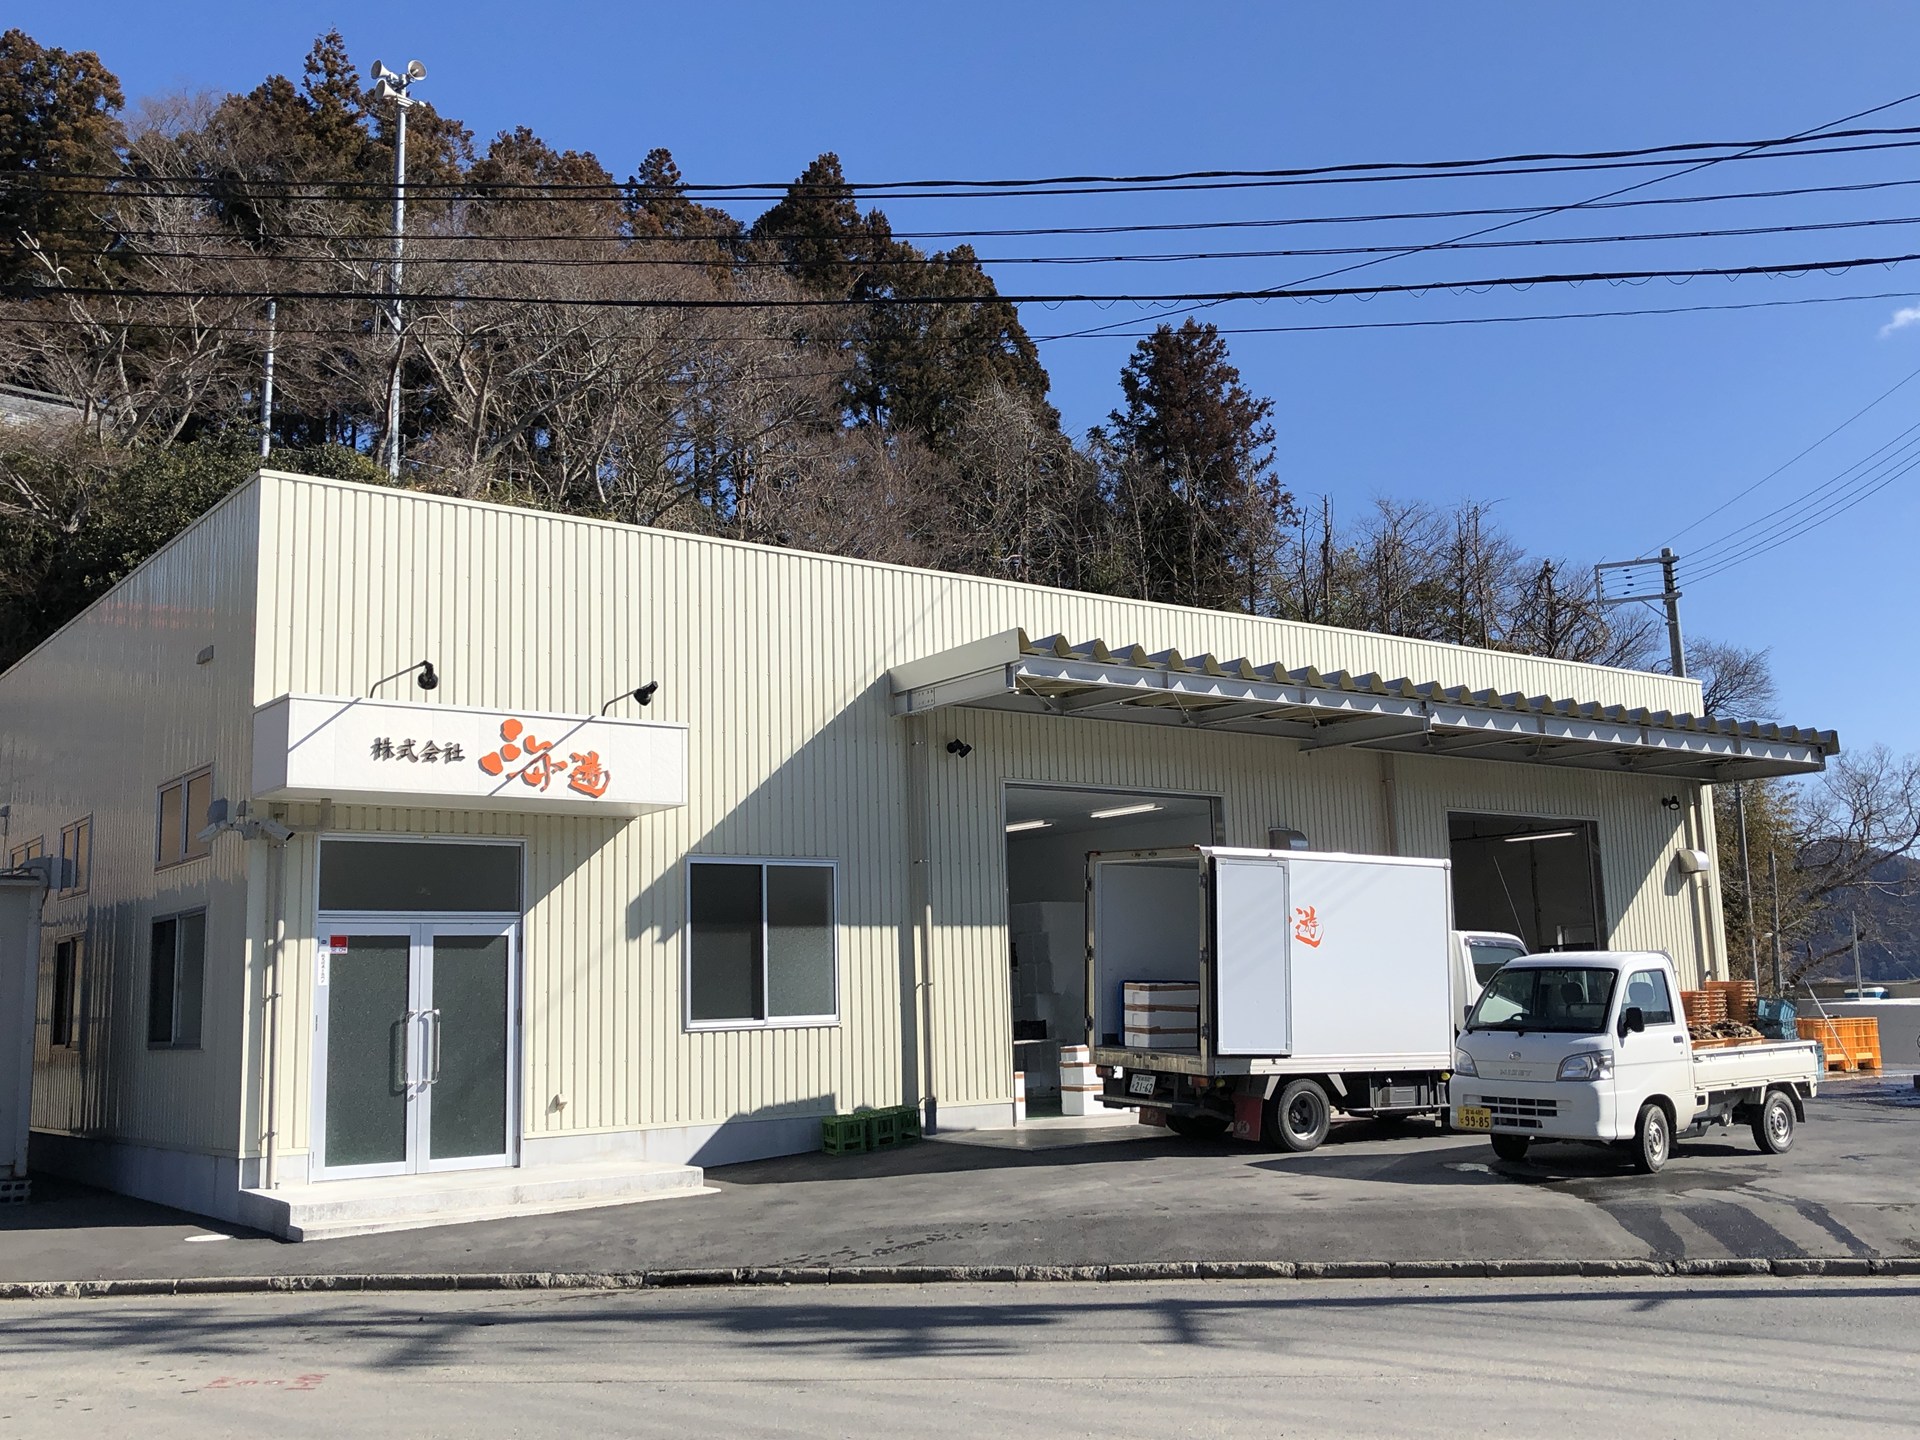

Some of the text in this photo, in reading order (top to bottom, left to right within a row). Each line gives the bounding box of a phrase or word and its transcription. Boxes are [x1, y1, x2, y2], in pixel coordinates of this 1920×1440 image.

[370, 737, 466, 764] 株式会社
[1288, 905, 1324, 948] 遊
[1465, 1116, 1490, 1128] 99-85
